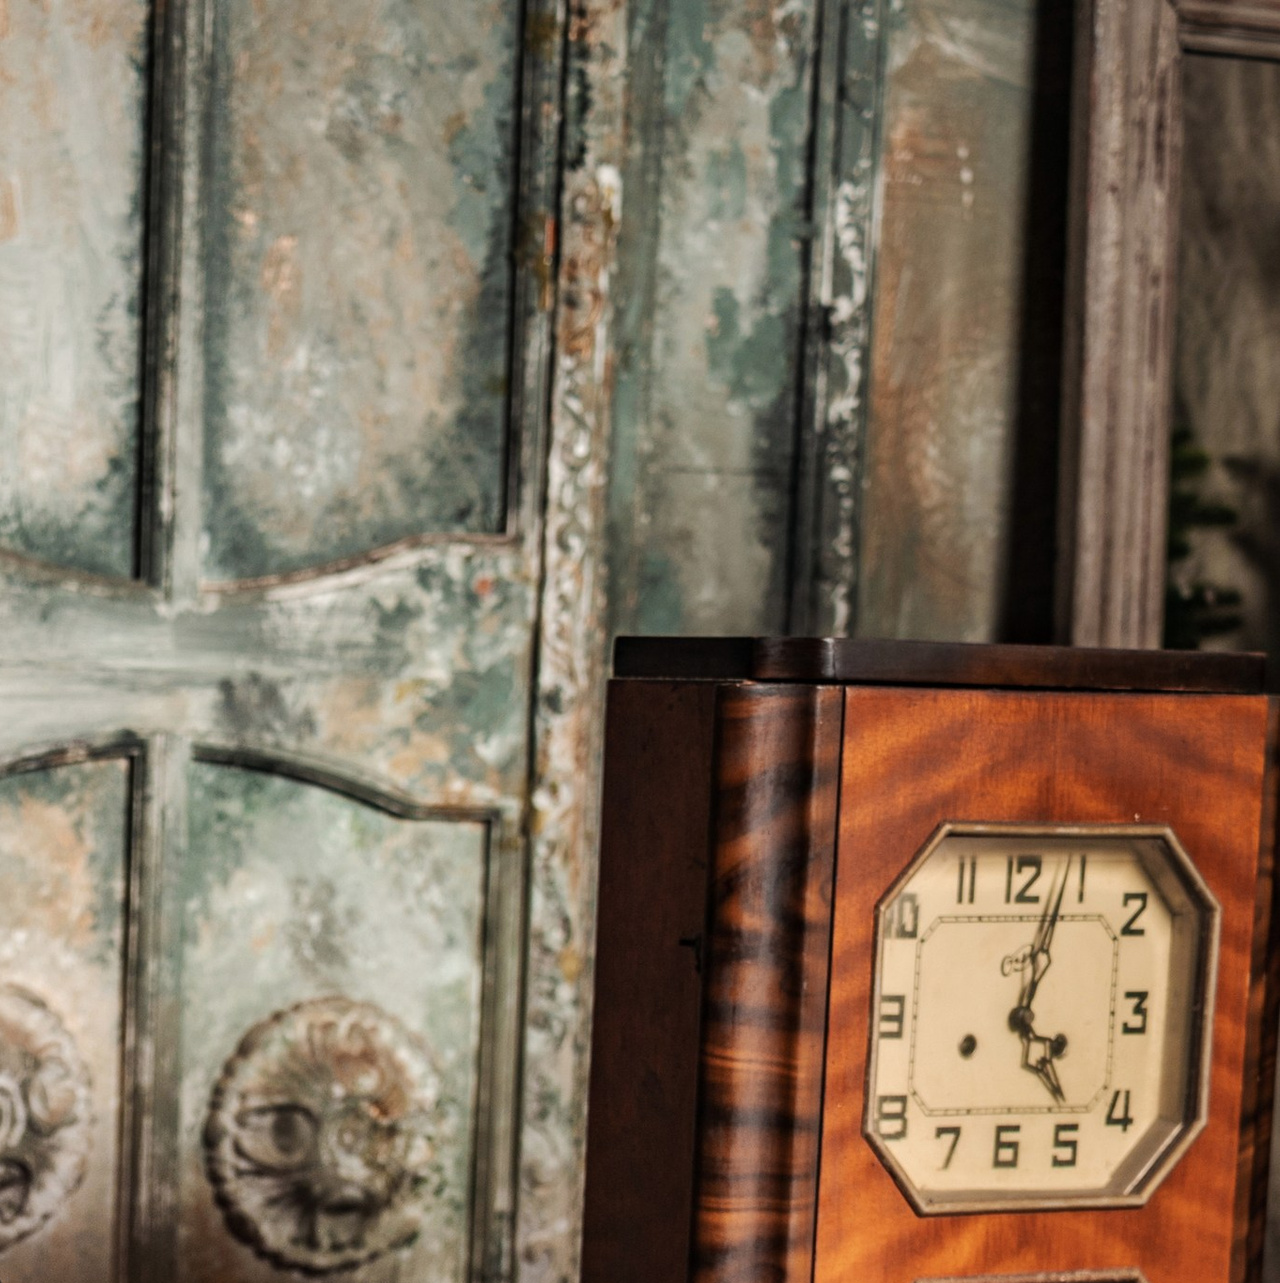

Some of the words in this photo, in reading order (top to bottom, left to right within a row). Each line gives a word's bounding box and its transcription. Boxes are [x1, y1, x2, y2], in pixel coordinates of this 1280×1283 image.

[1004, 855, 1043, 904] 12
[1078, 855, 1086, 903] 1
[1121, 892, 1149, 937] 2
[1122, 991, 1149, 1034] 3
[1105, 1090, 1133, 1132] 4
[935, 1126, 962, 1170] 7
[992, 1125, 1021, 1169] 6
[1051, 1124, 1080, 1167] 5
